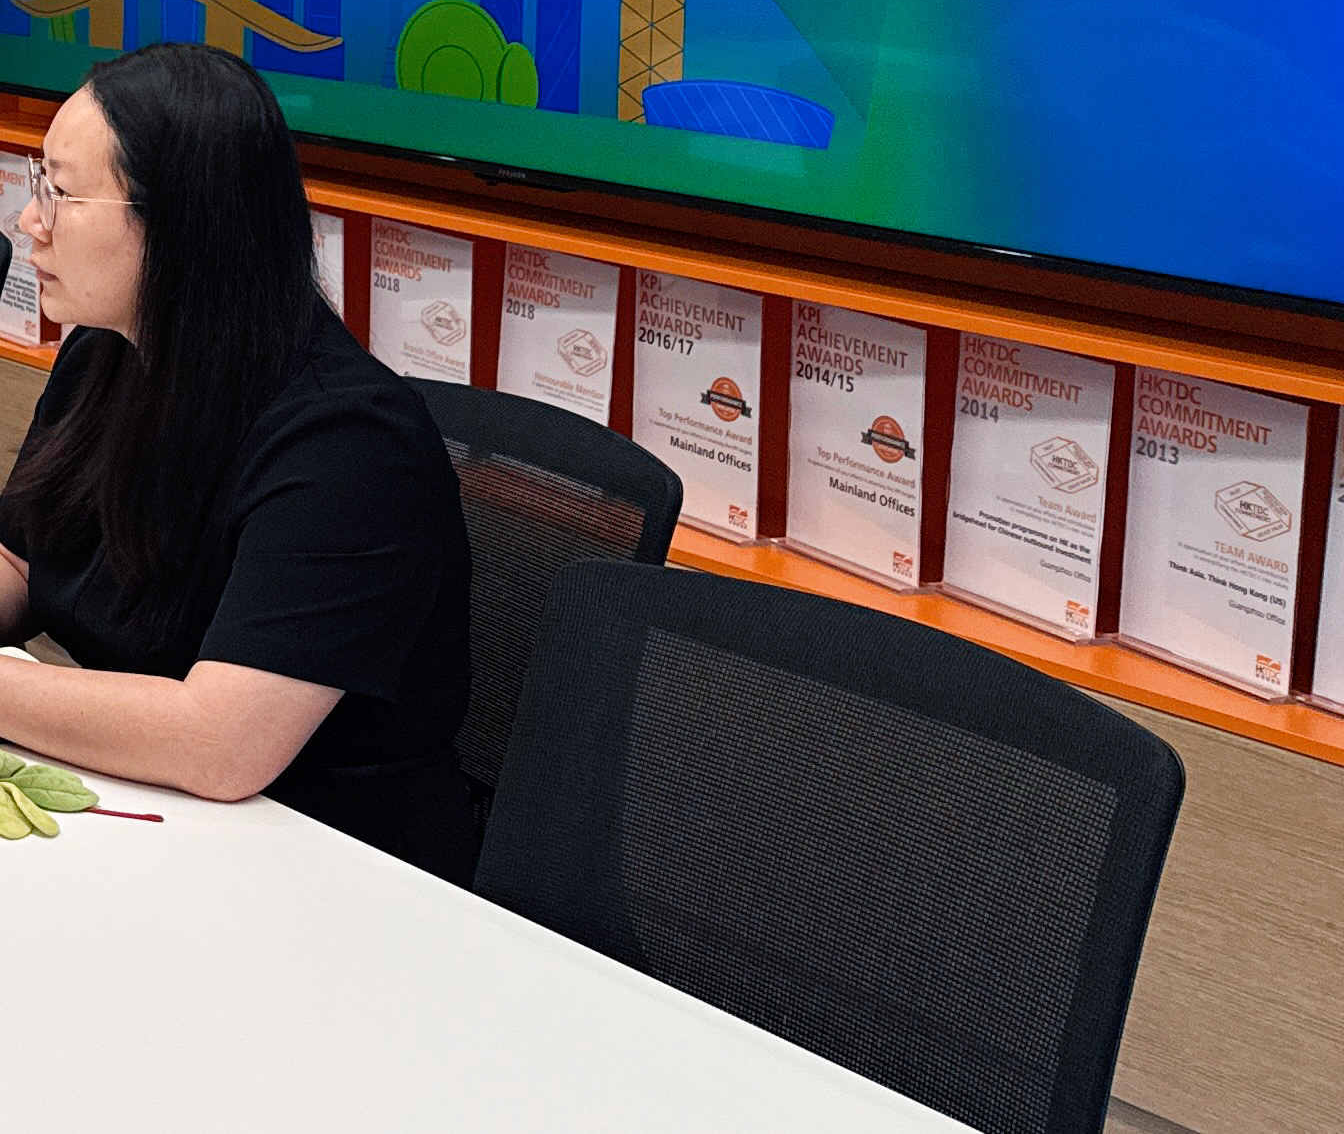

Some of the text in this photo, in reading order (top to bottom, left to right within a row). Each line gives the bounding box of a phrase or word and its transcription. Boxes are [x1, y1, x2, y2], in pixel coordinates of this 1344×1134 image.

[374, 240, 454, 273] COMMITMENT
[374, 256, 423, 282] AWARDS
[510, 249, 551, 271] HKTDC
[373, 272, 400, 293] 2018
[507, 282, 560, 308] AWARDS
[508, 266, 596, 299] COMMITMENT
[639, 273, 662, 291] KPI
[506, 298, 535, 321] 2018
[639, 310, 702, 340] AWARDS
[640, 291, 745, 332] ACHIEVEMENT
[798, 303, 820, 324] KPI
[638, 327, 694, 355] 2016/17
[797, 324, 909, 369] ACHIEVEMENT
[964, 337, 1021, 366] HKTDC
[796, 343, 863, 376] AWARDS
[796, 361, 854, 392] 2014/15
[963, 356, 1082, 404] COMMITMENT
[1140, 373, 1202, 406] HKTDC
[960, 396, 999, 423] 2014
[962, 377, 1033, 412] AWARDS
[1137, 416, 1218, 454] AWARDS
[1138, 395, 1272, 446] COMMITMENT
[670, 435, 715, 460] Mainland
[718, 452, 752, 472] Offices
[1136, 436, 1180, 465] 2013
[829, 477, 876, 503] Mainland
[879, 495, 915, 517] Offices
[1214, 540, 1246, 561] TEAM
[1247, 551, 1289, 574] AWARD
